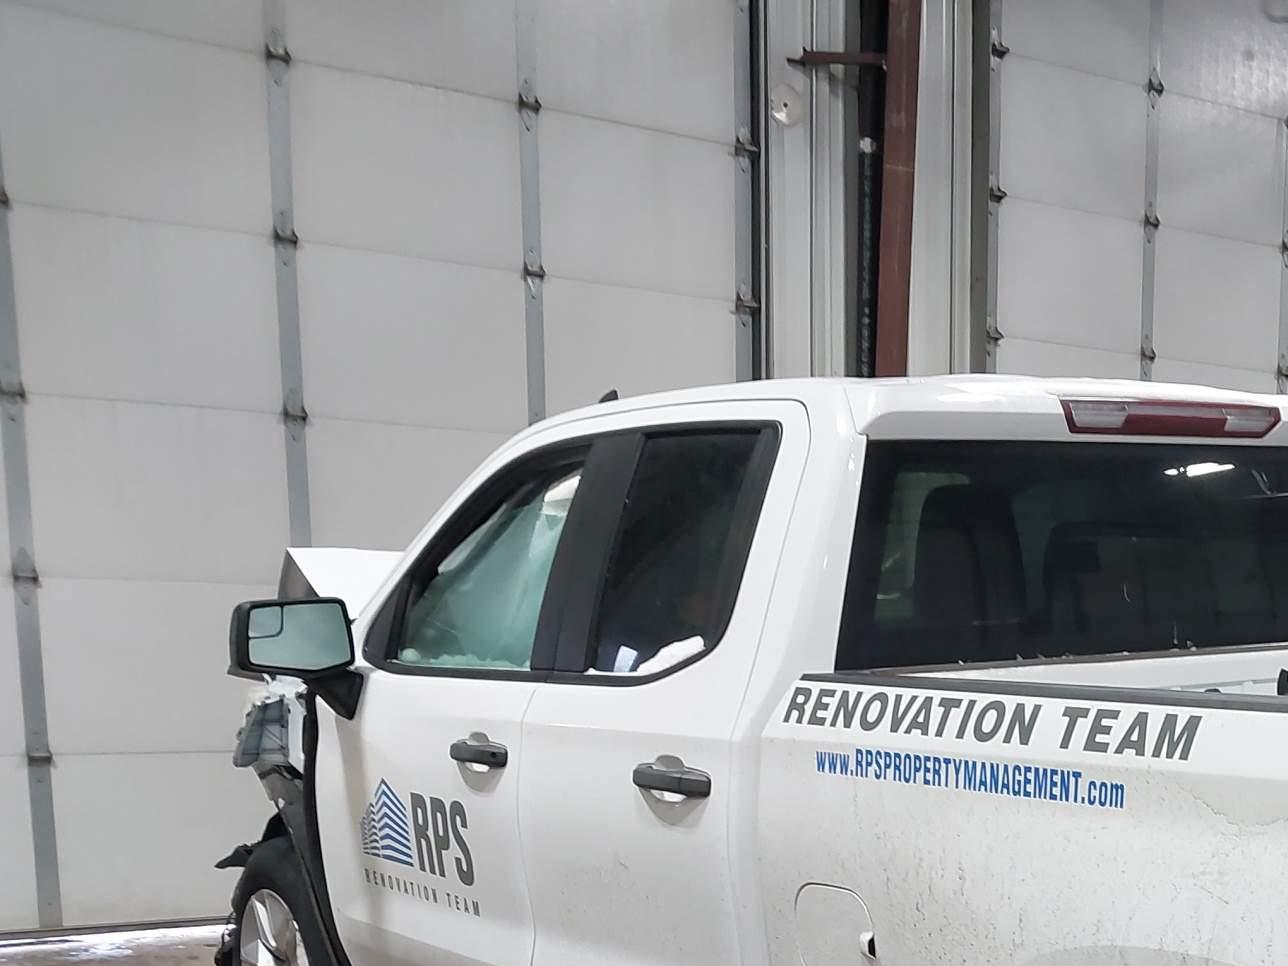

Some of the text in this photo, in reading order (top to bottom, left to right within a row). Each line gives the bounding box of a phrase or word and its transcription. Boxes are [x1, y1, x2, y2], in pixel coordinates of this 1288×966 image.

[783, 687, 1203, 761] RENOVATION TEAM
[410, 792, 474, 886] RPS
[364, 867, 481, 917] RENOVATION TEAM
